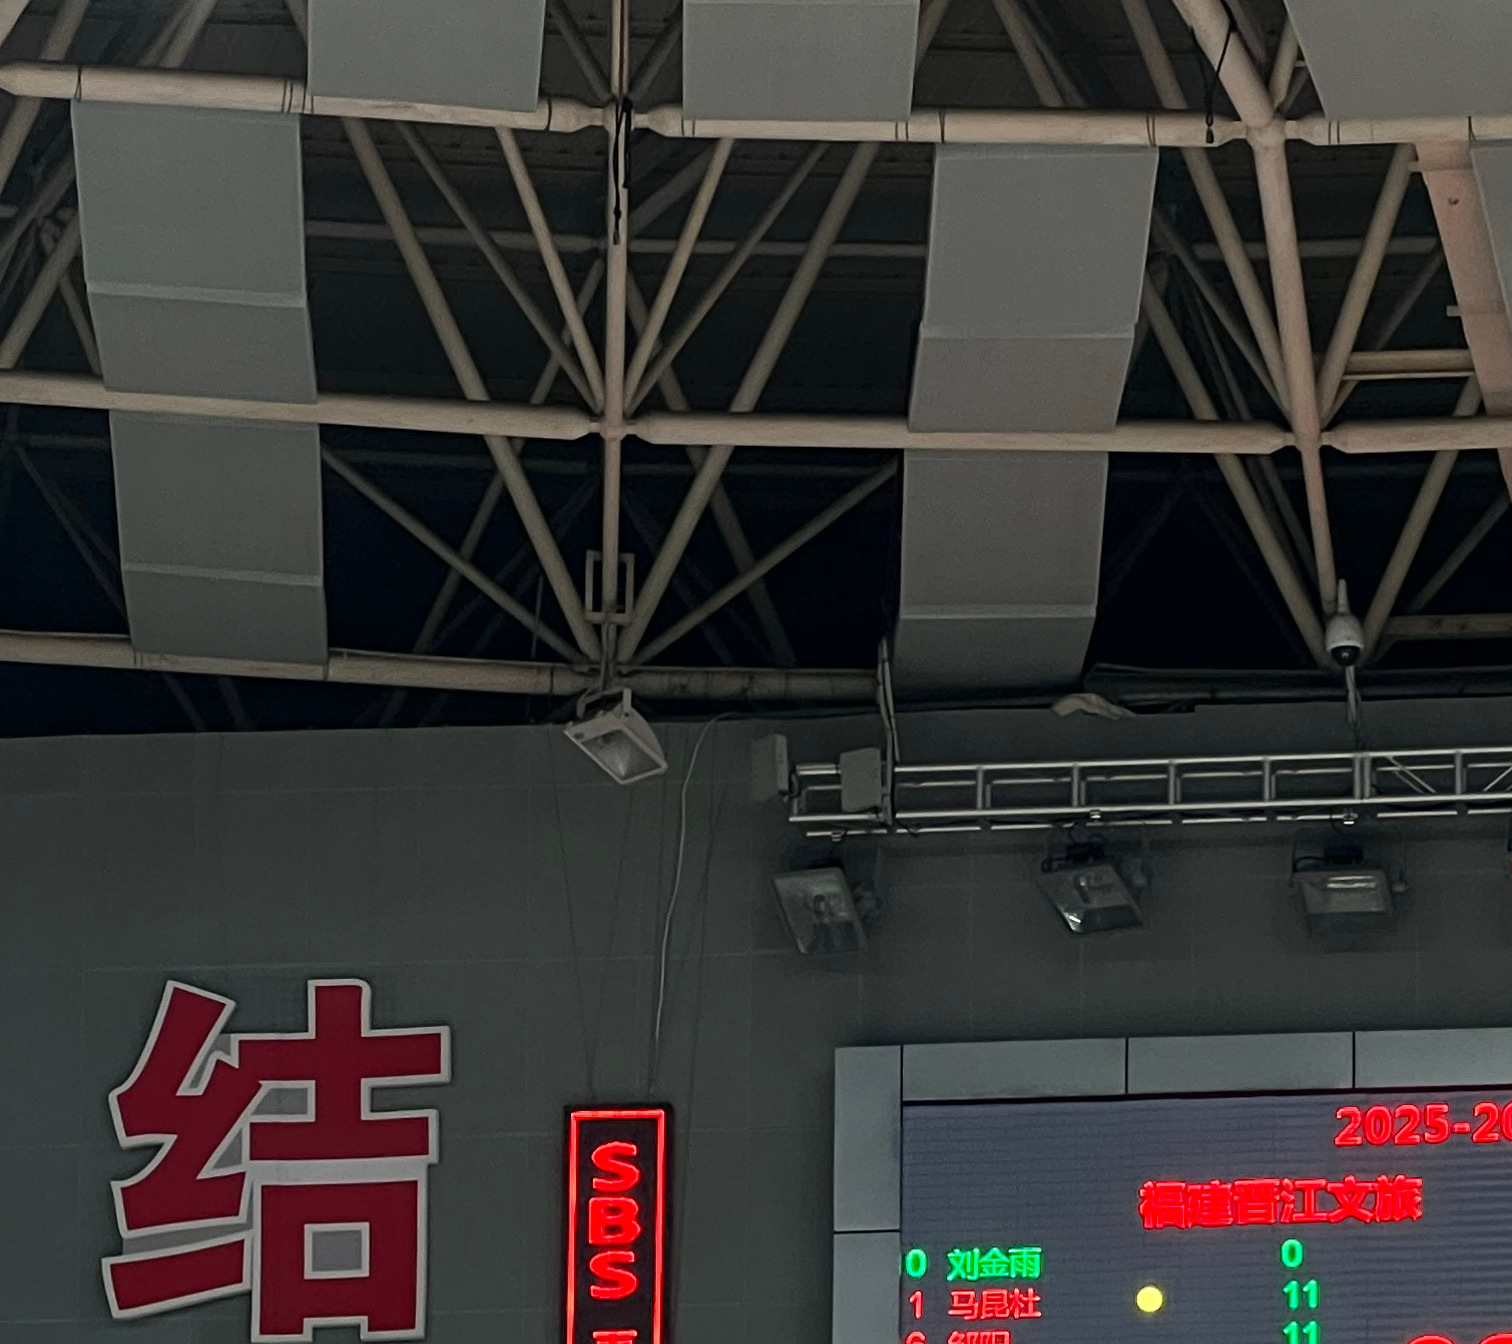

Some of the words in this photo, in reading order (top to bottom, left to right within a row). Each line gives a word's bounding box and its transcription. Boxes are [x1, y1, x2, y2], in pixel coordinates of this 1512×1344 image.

[101, 979, 451, 1344] 结
[588, 1141, 642, 1300] SBS
[1138, 1174, 1424, 1230] 福建晋江文旅
[905, 1248, 929, 1279] 0
[1281, 1239, 1303, 1270] 0
[909, 1289, 924, 1320] 1
[1282, 1279, 1320, 1311] 11
